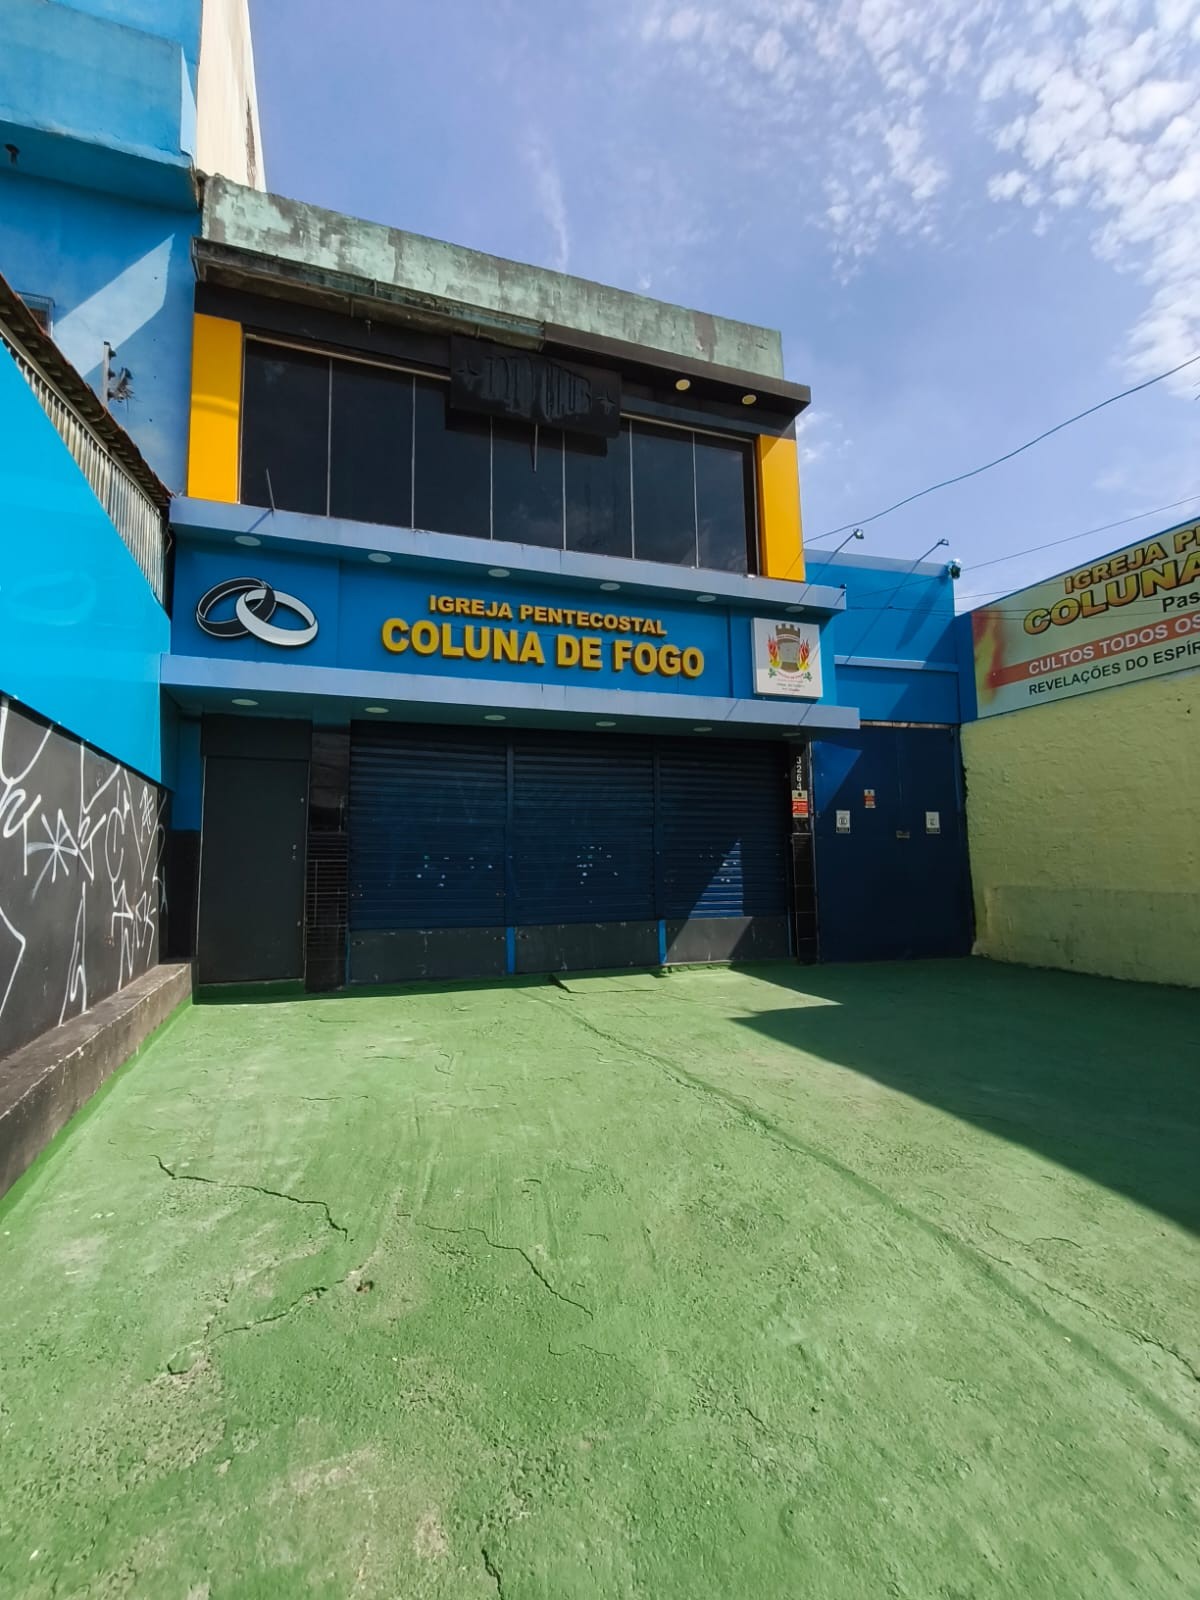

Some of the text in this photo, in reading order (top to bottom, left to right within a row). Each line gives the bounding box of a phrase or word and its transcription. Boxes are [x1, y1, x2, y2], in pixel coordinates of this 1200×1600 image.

[1023, 549, 1200, 635] COLUNA
[1064, 542, 1168, 594] IGREJA
[429, 594, 667, 636] IGREJA PENTECOSTAL
[381, 617, 705, 678] COLUNA DE FOGO
[1028, 645, 1094, 675] CULTOS
[1099, 623, 1168, 655] TODOS
[1029, 640, 1200, 695] REVELAÇÕES DO ESPÍR
